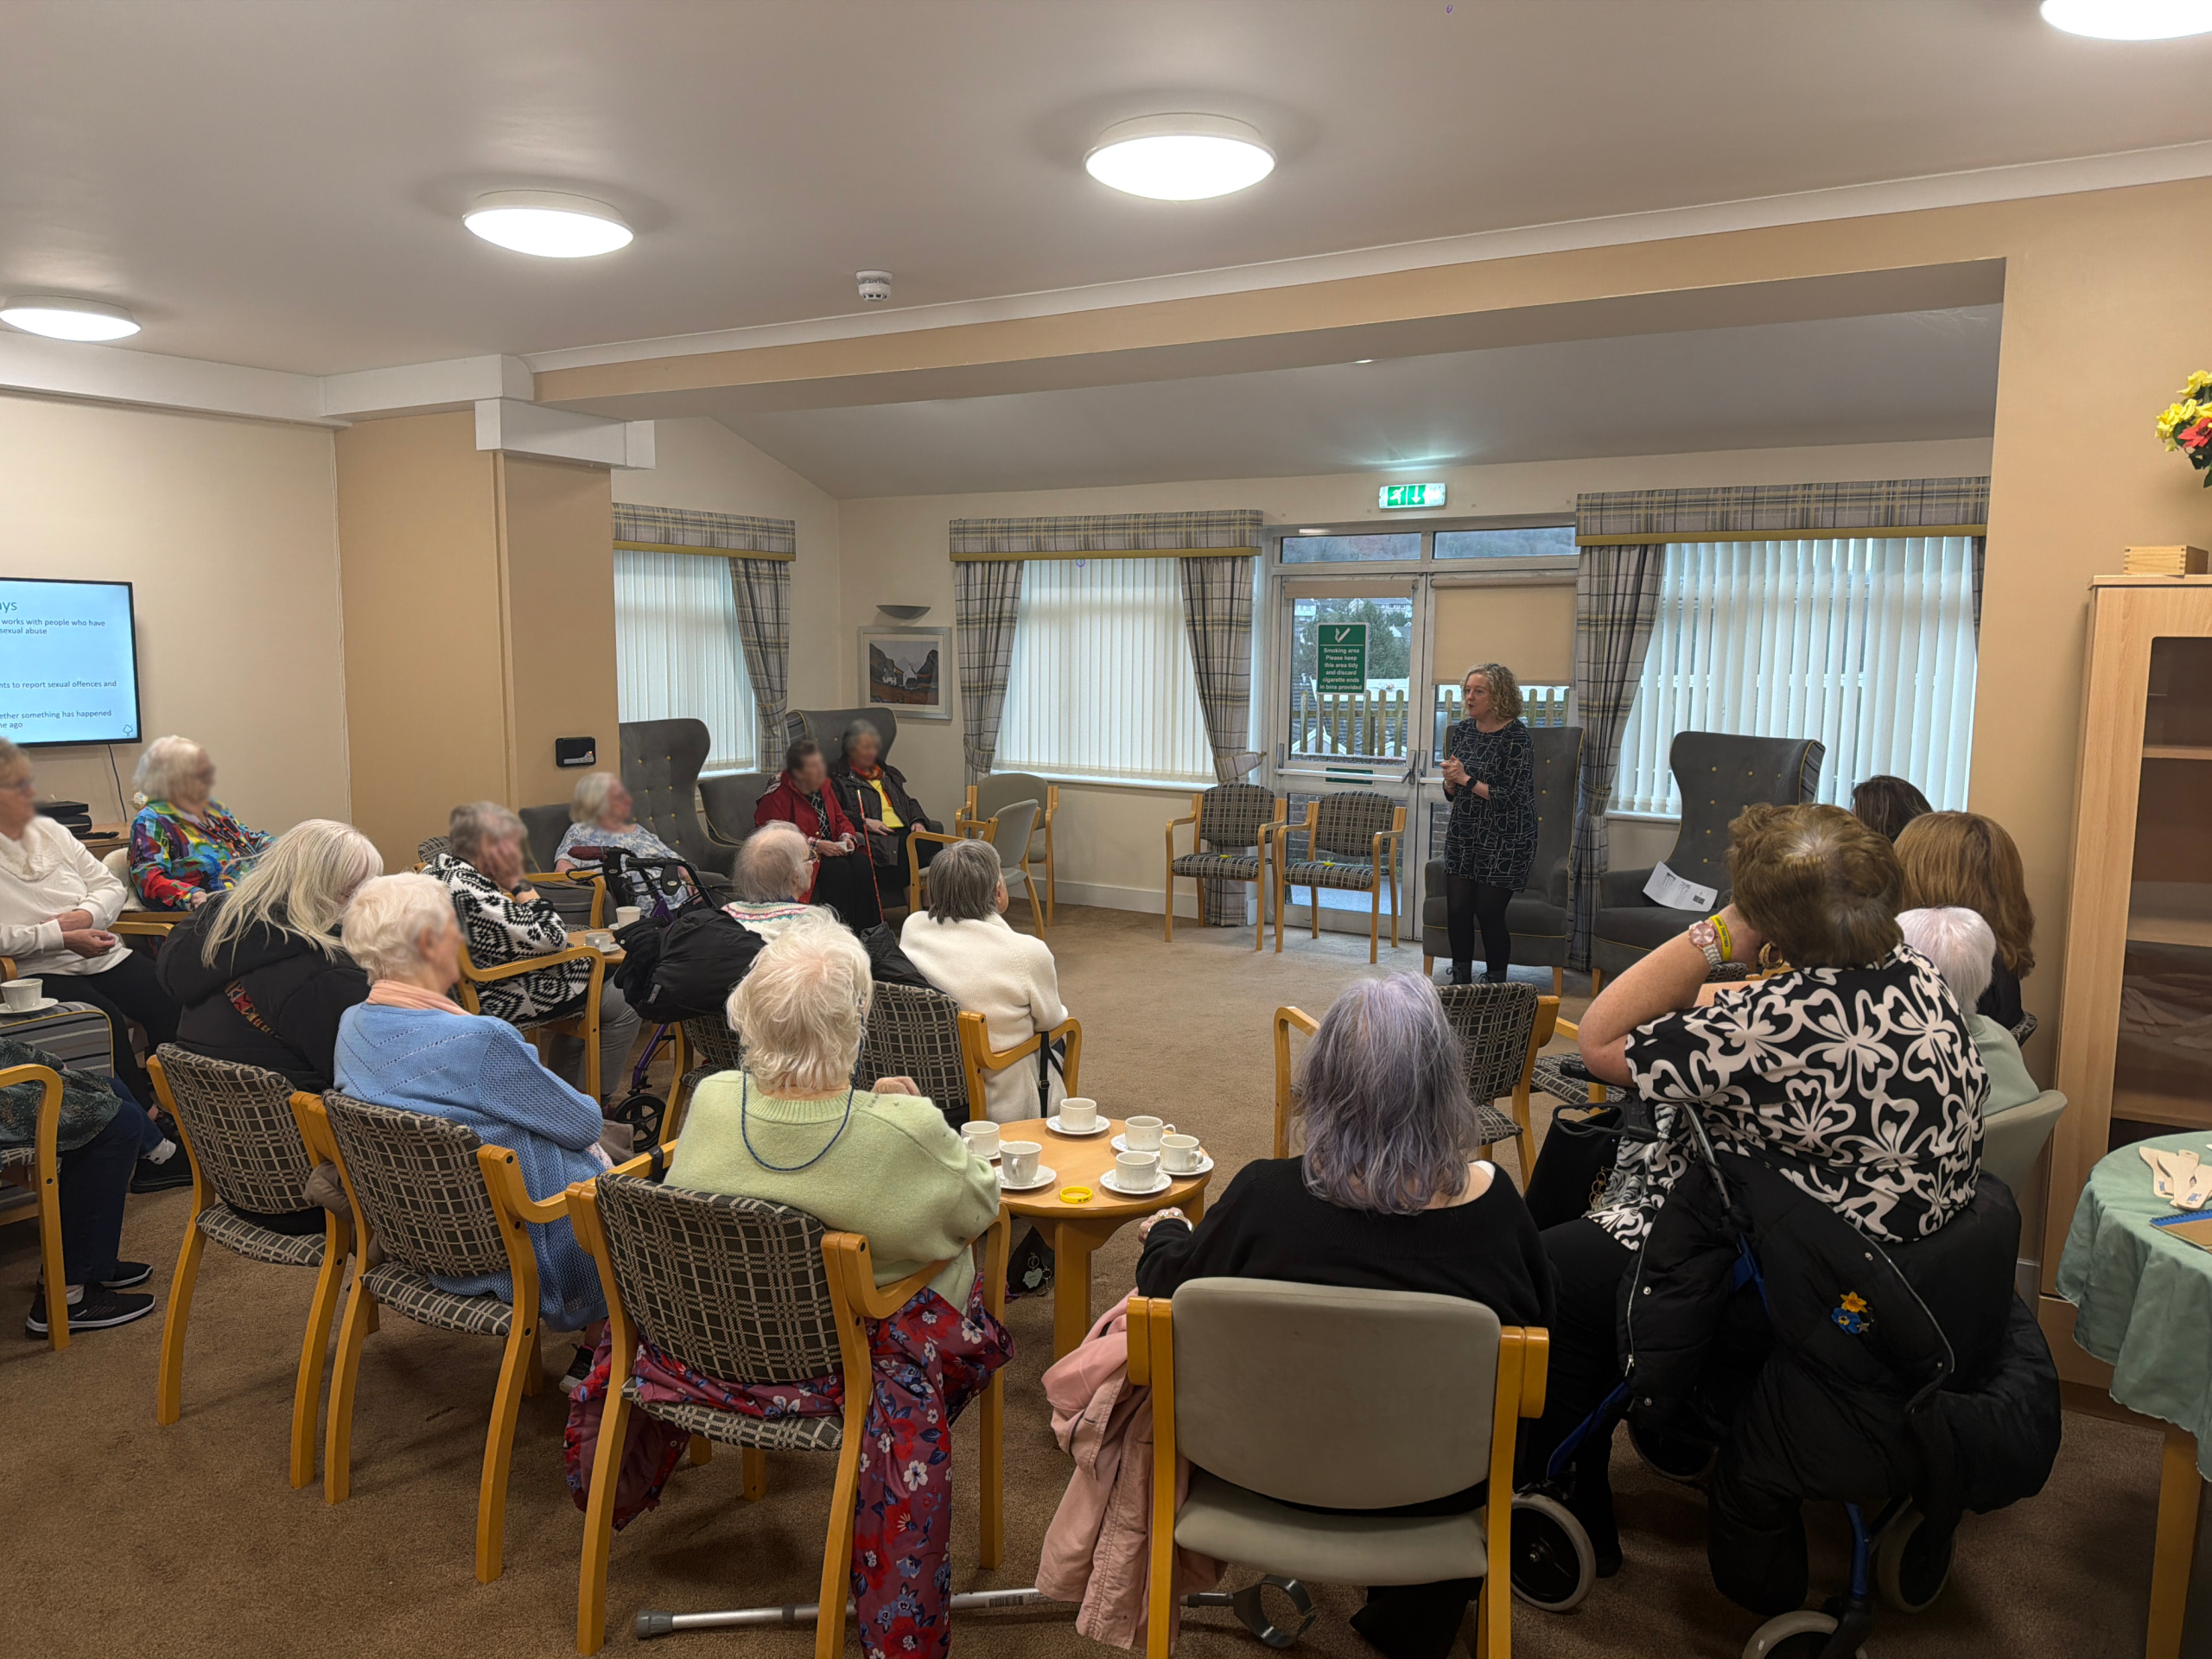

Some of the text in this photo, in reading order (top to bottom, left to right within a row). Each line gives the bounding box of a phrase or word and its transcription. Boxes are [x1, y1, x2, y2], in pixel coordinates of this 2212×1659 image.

[45, 619, 70, 627] people
[21, 711, 60, 720] something
[76, 709, 112, 718] happened
